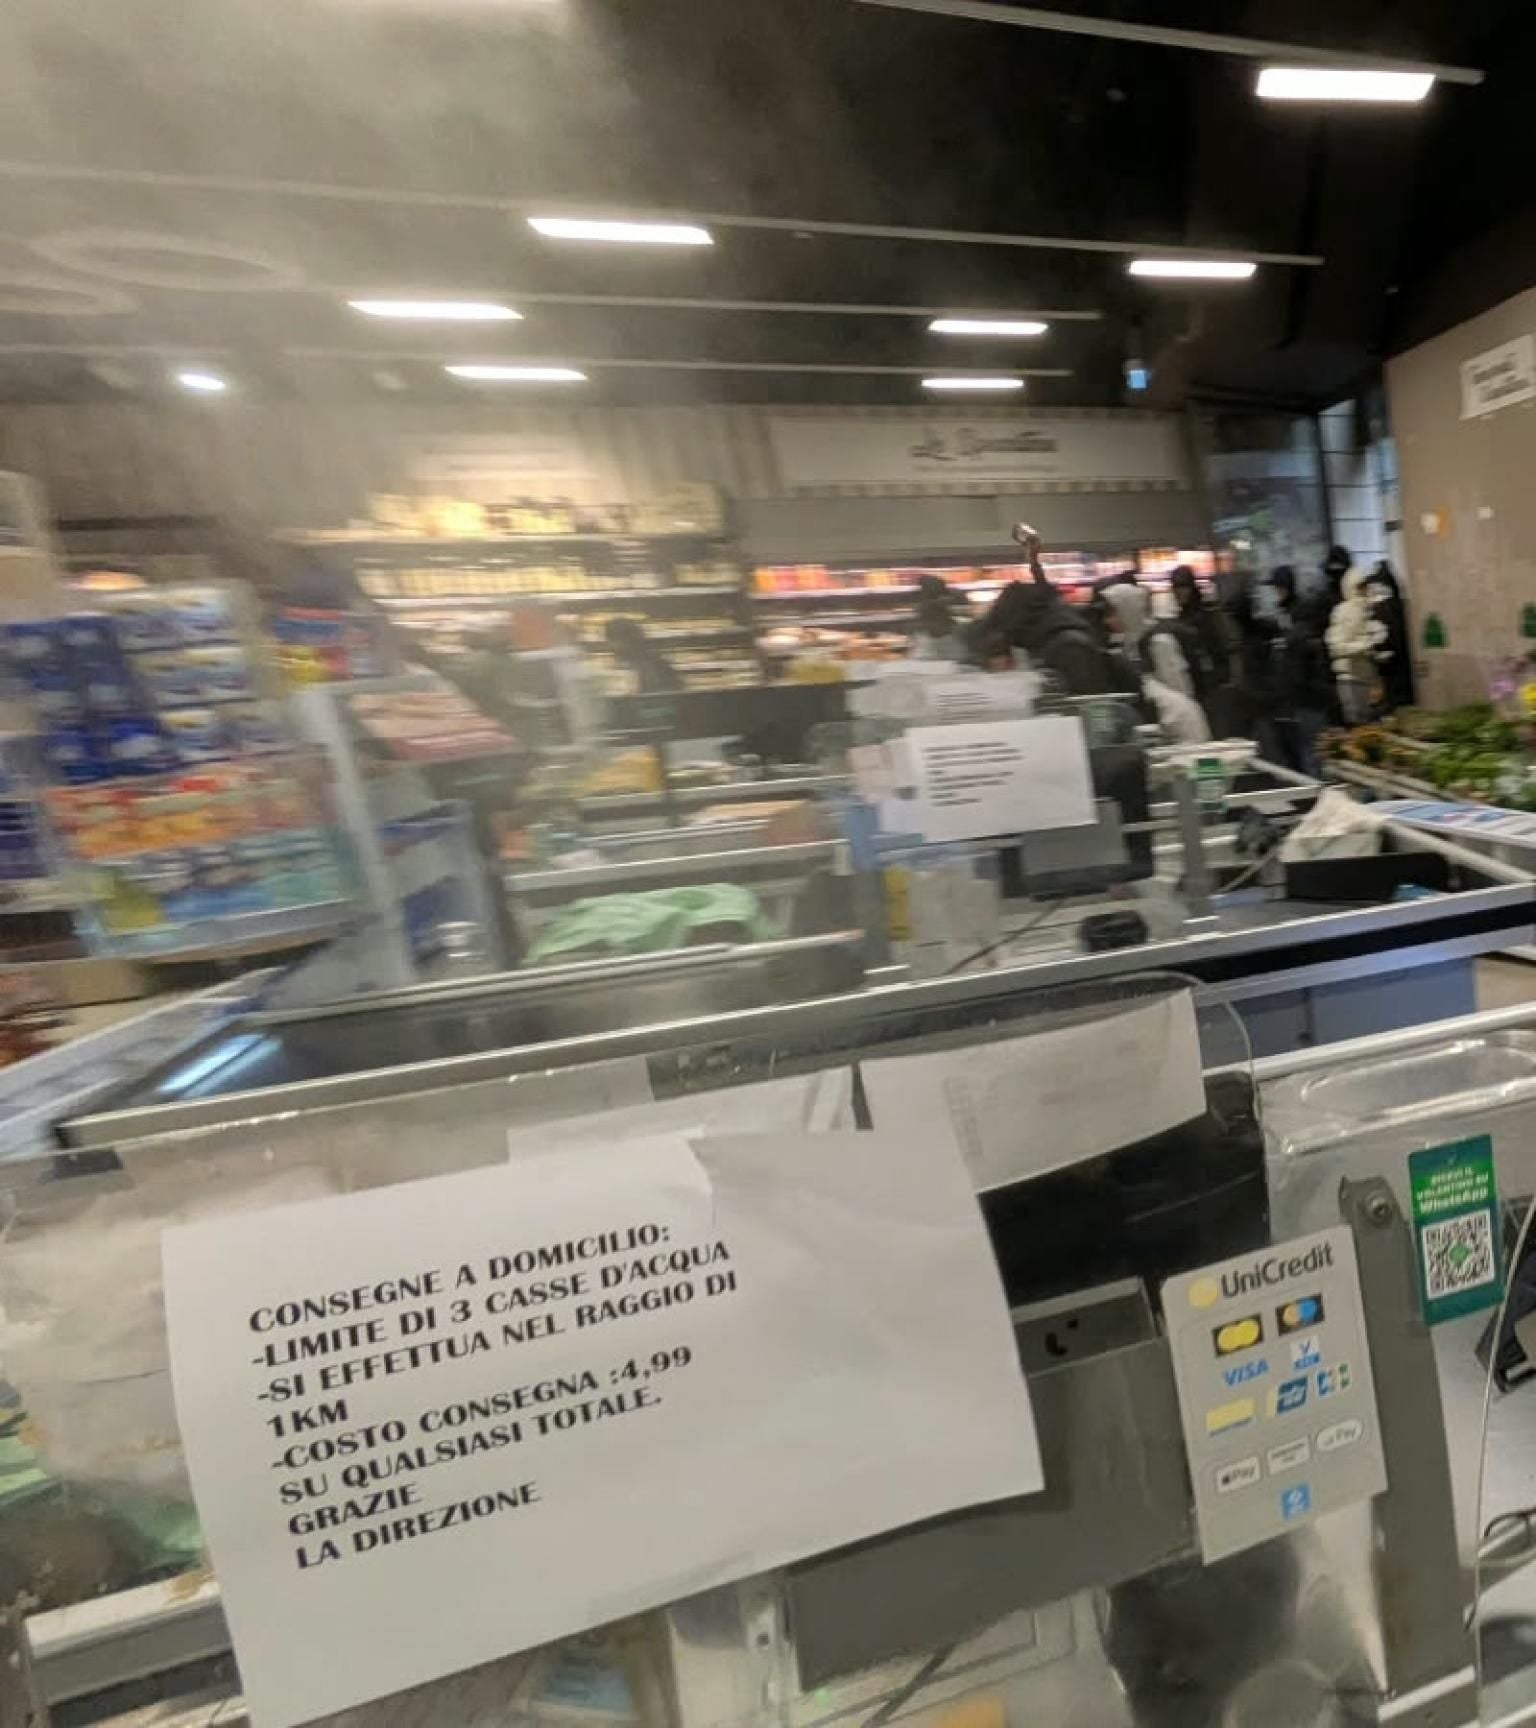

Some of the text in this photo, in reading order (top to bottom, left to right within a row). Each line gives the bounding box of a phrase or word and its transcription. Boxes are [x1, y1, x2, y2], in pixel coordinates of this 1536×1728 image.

[249, 1224, 671, 1333] CONSEGNE A DOMICILIO:
[252, 1241, 731, 1367] -LIMITE DI 3 CASSE D'ACQUA
[1221, 1241, 1334, 1298] UniCredit
[256, 1270, 738, 1402] -SI EFFETTUA NEL RAGGIO DI
[1222, 1359, 1269, 1387] VISA
[272, 1346, 692, 1469] -COSTO CONSEGNA :4,99
[280, 1386, 662, 1505] SU QUALSIASI TOTALE.
[288, 1484, 423, 1535] GRAZIE
[296, 1482, 540, 1569] LA DIREZIONE
